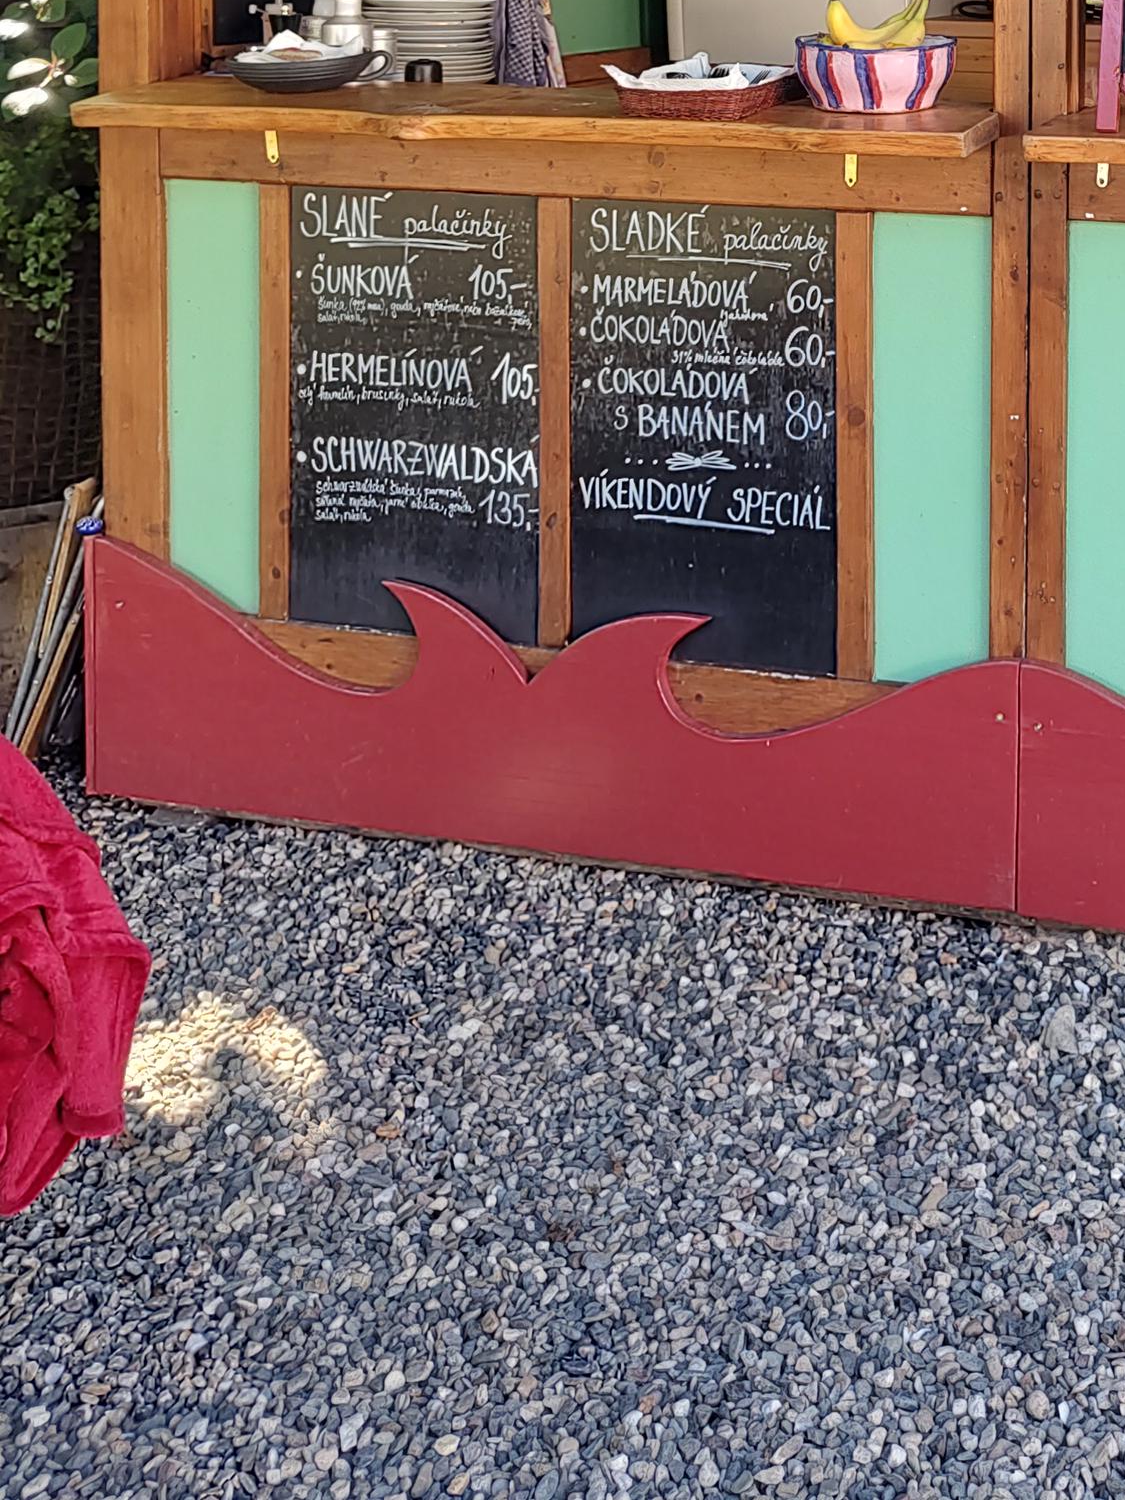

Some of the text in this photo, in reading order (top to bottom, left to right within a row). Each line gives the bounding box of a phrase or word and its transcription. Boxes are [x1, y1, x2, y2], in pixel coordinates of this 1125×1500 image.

[300, 191, 512, 265] SLANÉ palačinky
[589, 204, 828, 272] SLADKÉ palačinky
[311, 254, 419, 300] ŠUNKOVÁ
[592, 271, 757, 309] MARMELÁDOVÁ
[590, 307, 730, 353] ČOKOLÁDOVÁ
[310, 346, 484, 393] HERMELÍNOVÁ
[599, 355, 758, 404] ČOKOLÁDOVÁ
[637, 401, 765, 446] BANÁNEM
[311, 435, 539, 488] SCHWARZWALDSKÁ
[579, 468, 831, 531] VÍKENDOVÝ SPECIÁL
